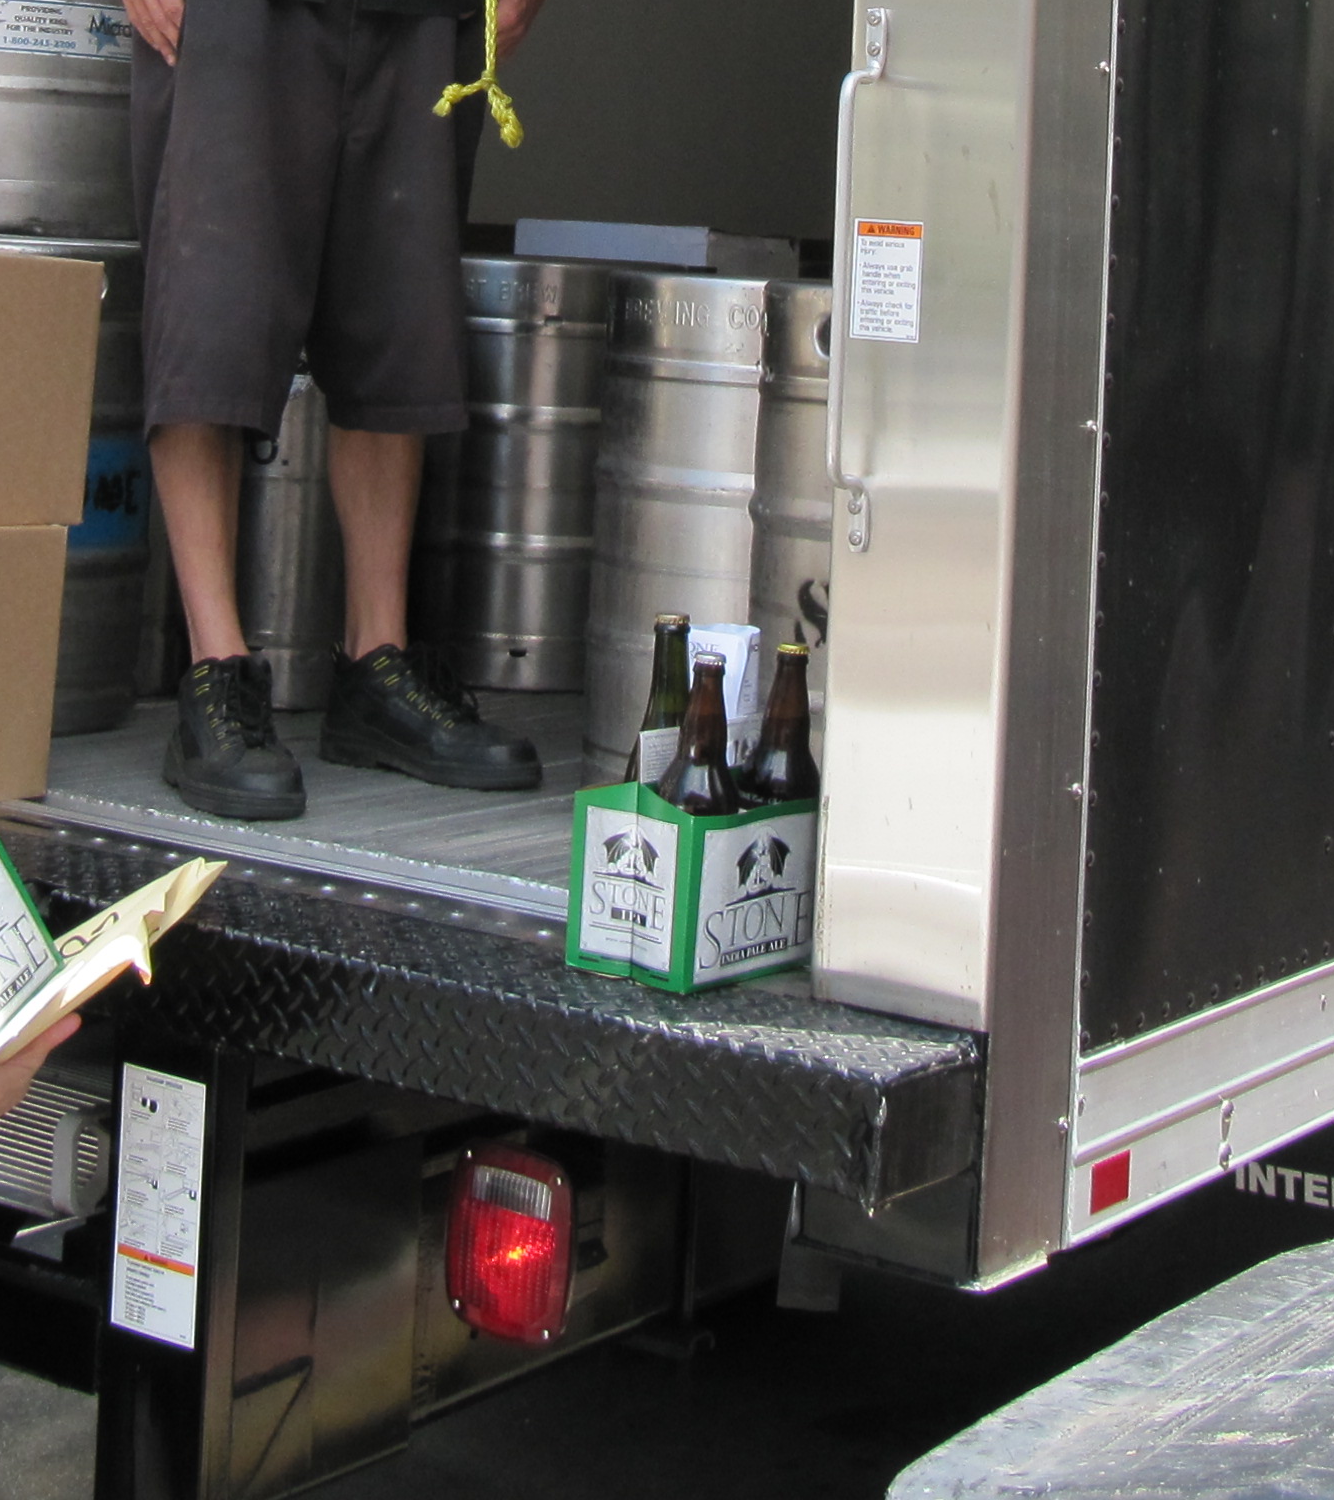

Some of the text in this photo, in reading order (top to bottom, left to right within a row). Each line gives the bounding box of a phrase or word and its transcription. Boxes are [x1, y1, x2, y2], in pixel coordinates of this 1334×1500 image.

[877, 224, 915, 236] WARNING
[589, 881, 666, 931] STONE
[621, 909, 643, 924] IPA
[699, 890, 812, 969] STONE
[746, 944, 766, 959] PALE
[768, 938, 787, 953] ALE
[14, 968, 33, 993] ALE
